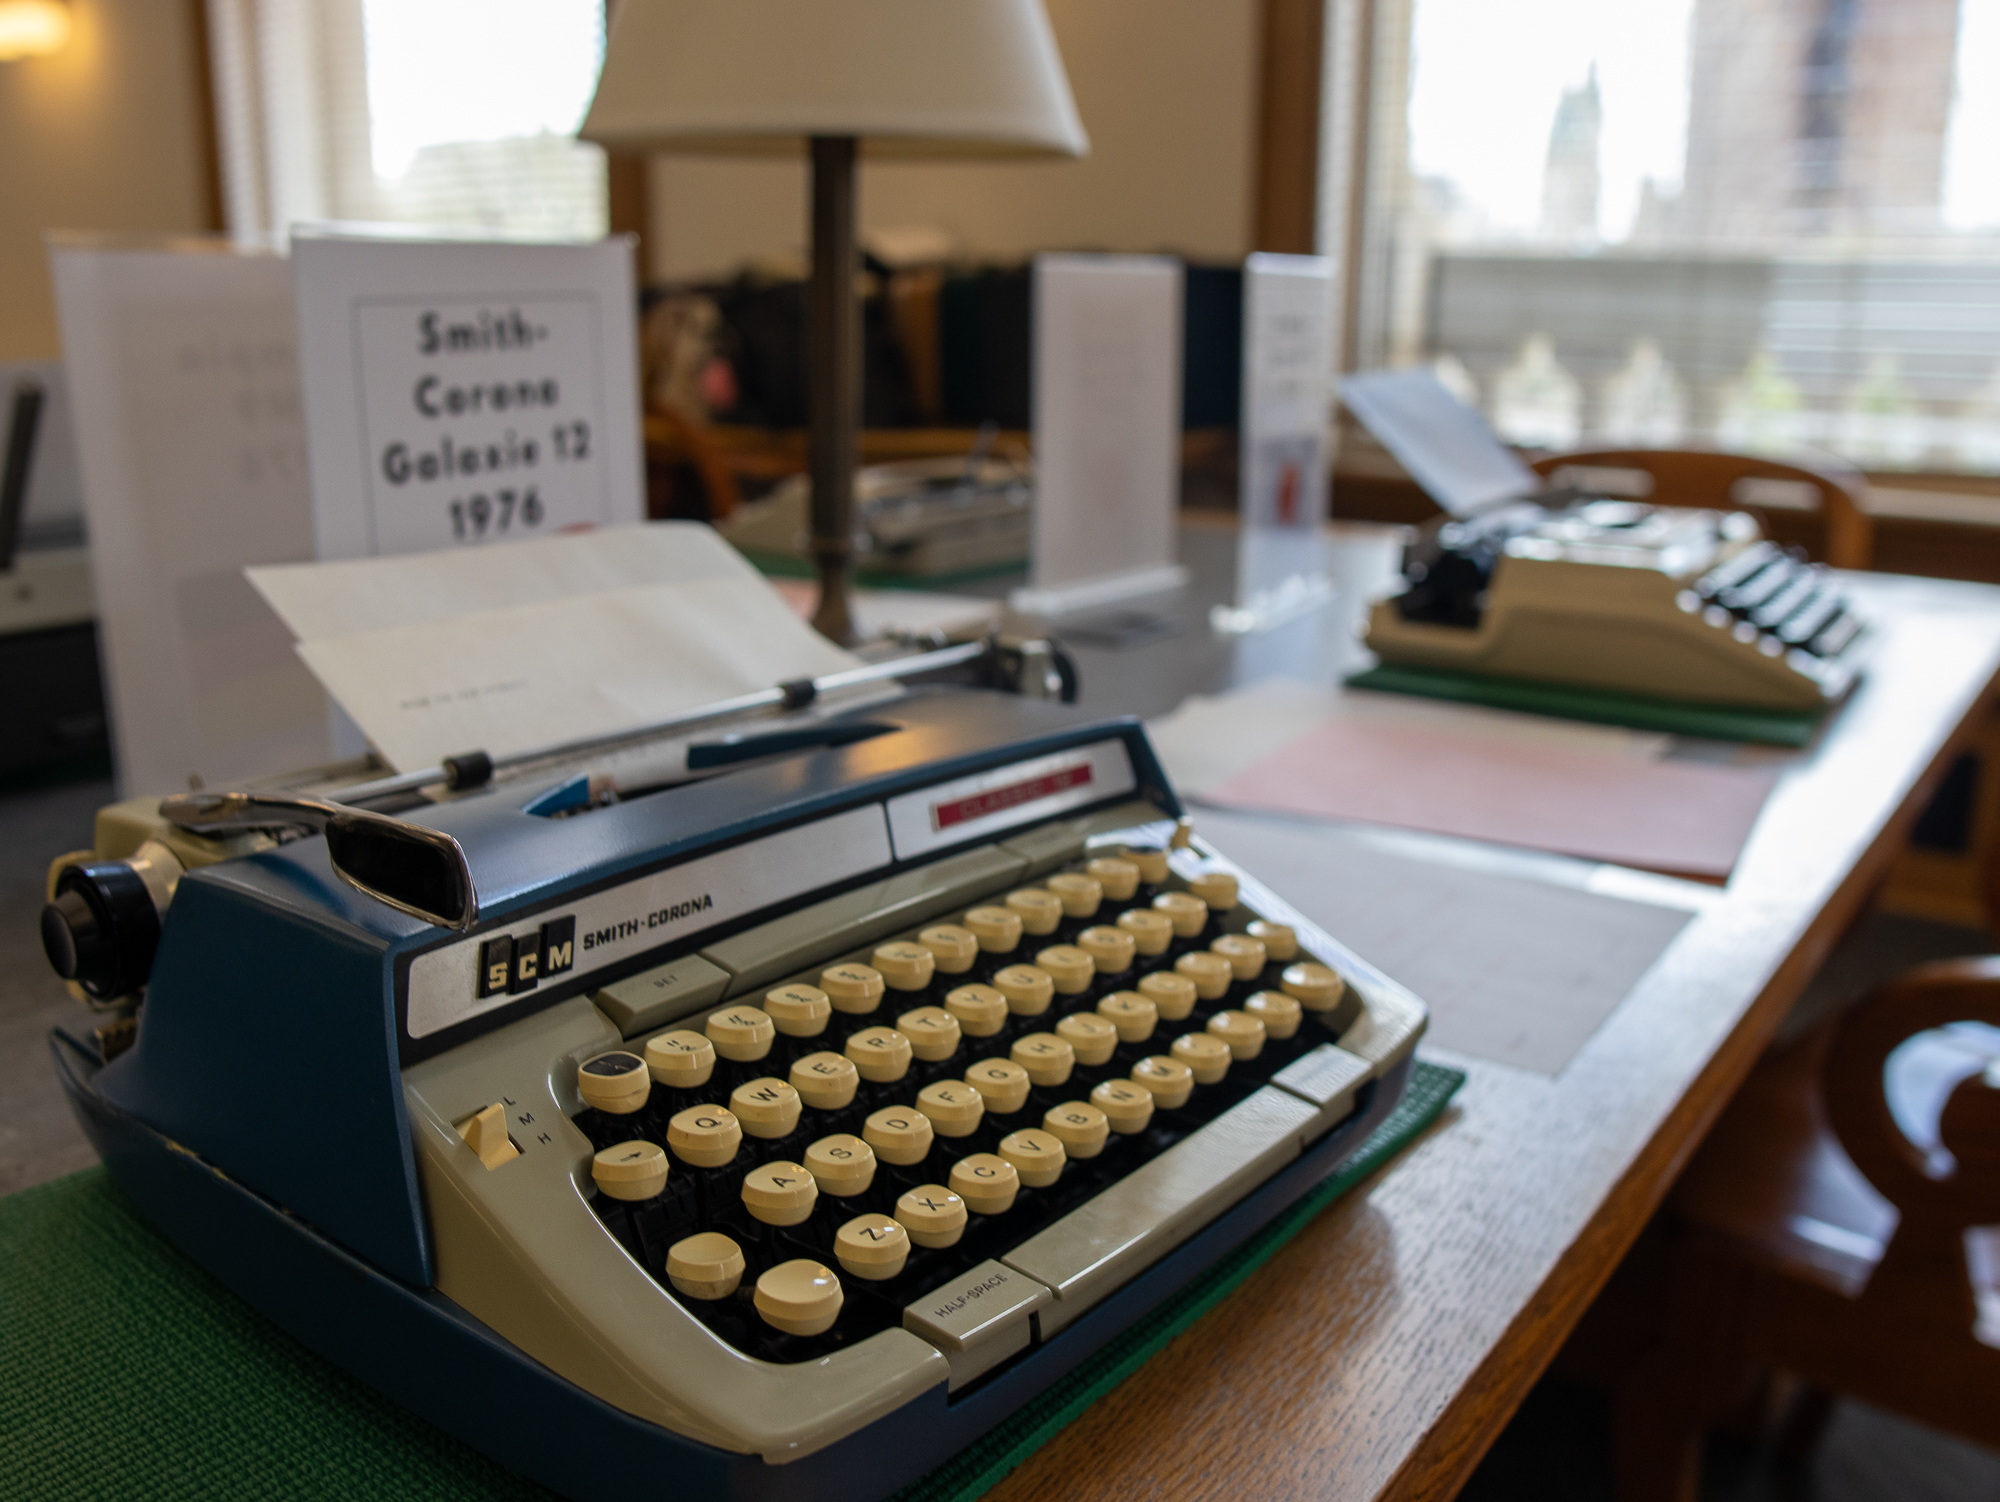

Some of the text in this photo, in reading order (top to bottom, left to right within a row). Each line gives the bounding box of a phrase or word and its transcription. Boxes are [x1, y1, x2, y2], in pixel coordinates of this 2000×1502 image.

[413, 373, 559, 419] Corona
[382, 419, 591, 487] Galaxie 12
[449, 483, 544, 540] 1976
[488, 941, 573, 990] SCM
[653, 974, 679, 989] SET
[916, 1017, 937, 1028] T
[867, 1037, 891, 1049] R
[812, 1062, 838, 1075] E
[503, 1096, 516, 1106] L
[749, 1087, 779, 1102] W
[938, 1090, 958, 1103] F
[1111, 1089, 1135, 1101] N
[518, 1112, 535, 1126] M
[695, 1117, 722, 1129] Q
[886, 1119, 910, 1130] D
[1066, 1114, 1088, 1125] B
[537, 1132, 552, 1145] H
[1019, 1139, 1042, 1152] V
[829, 1147, 853, 1160] S
[974, 1167, 996, 1178] C
[771, 1175, 796, 1188] A
[918, 1197, 945, 1211] X
[859, 1227, 887, 1242] Z
